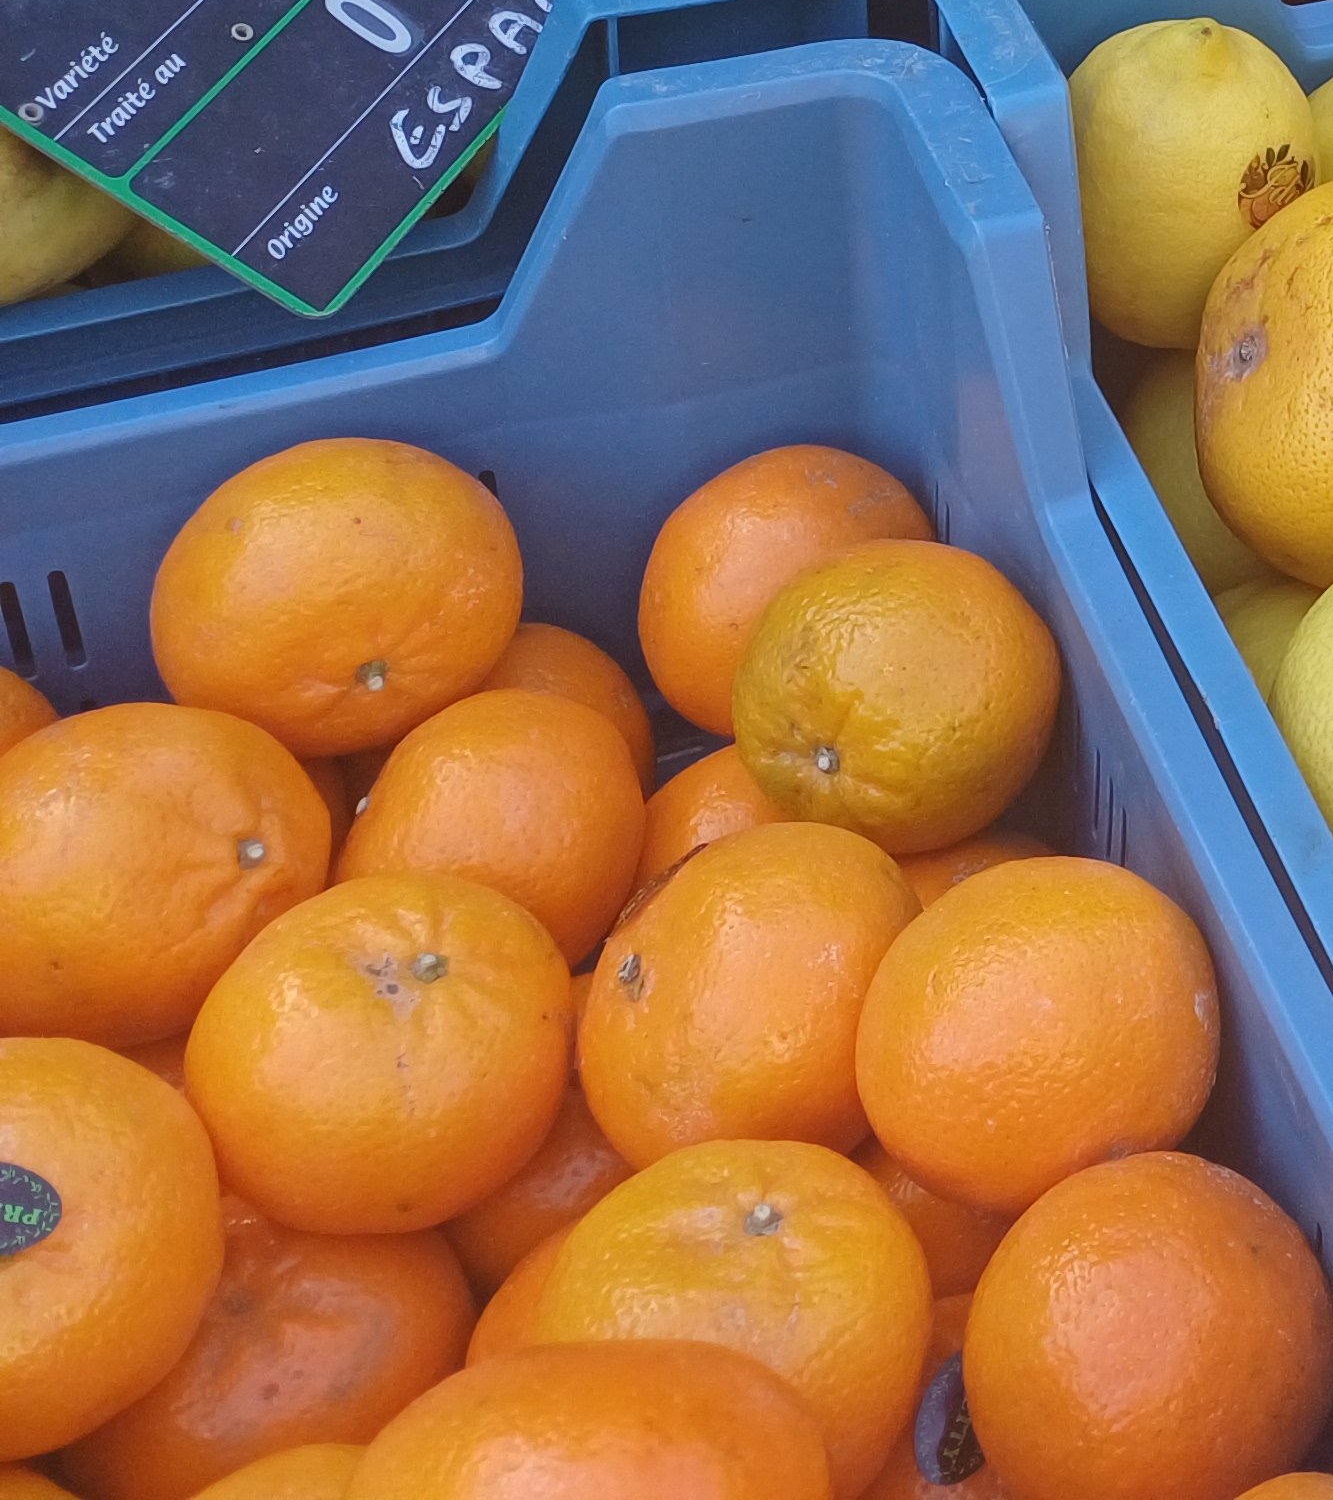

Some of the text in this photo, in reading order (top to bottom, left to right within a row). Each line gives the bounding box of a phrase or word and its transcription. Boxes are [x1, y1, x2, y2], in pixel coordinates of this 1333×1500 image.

[35, 31, 120, 111] Variété
[86, 52, 187, 144] Traité au
[267, 185, 339, 261] Origine
